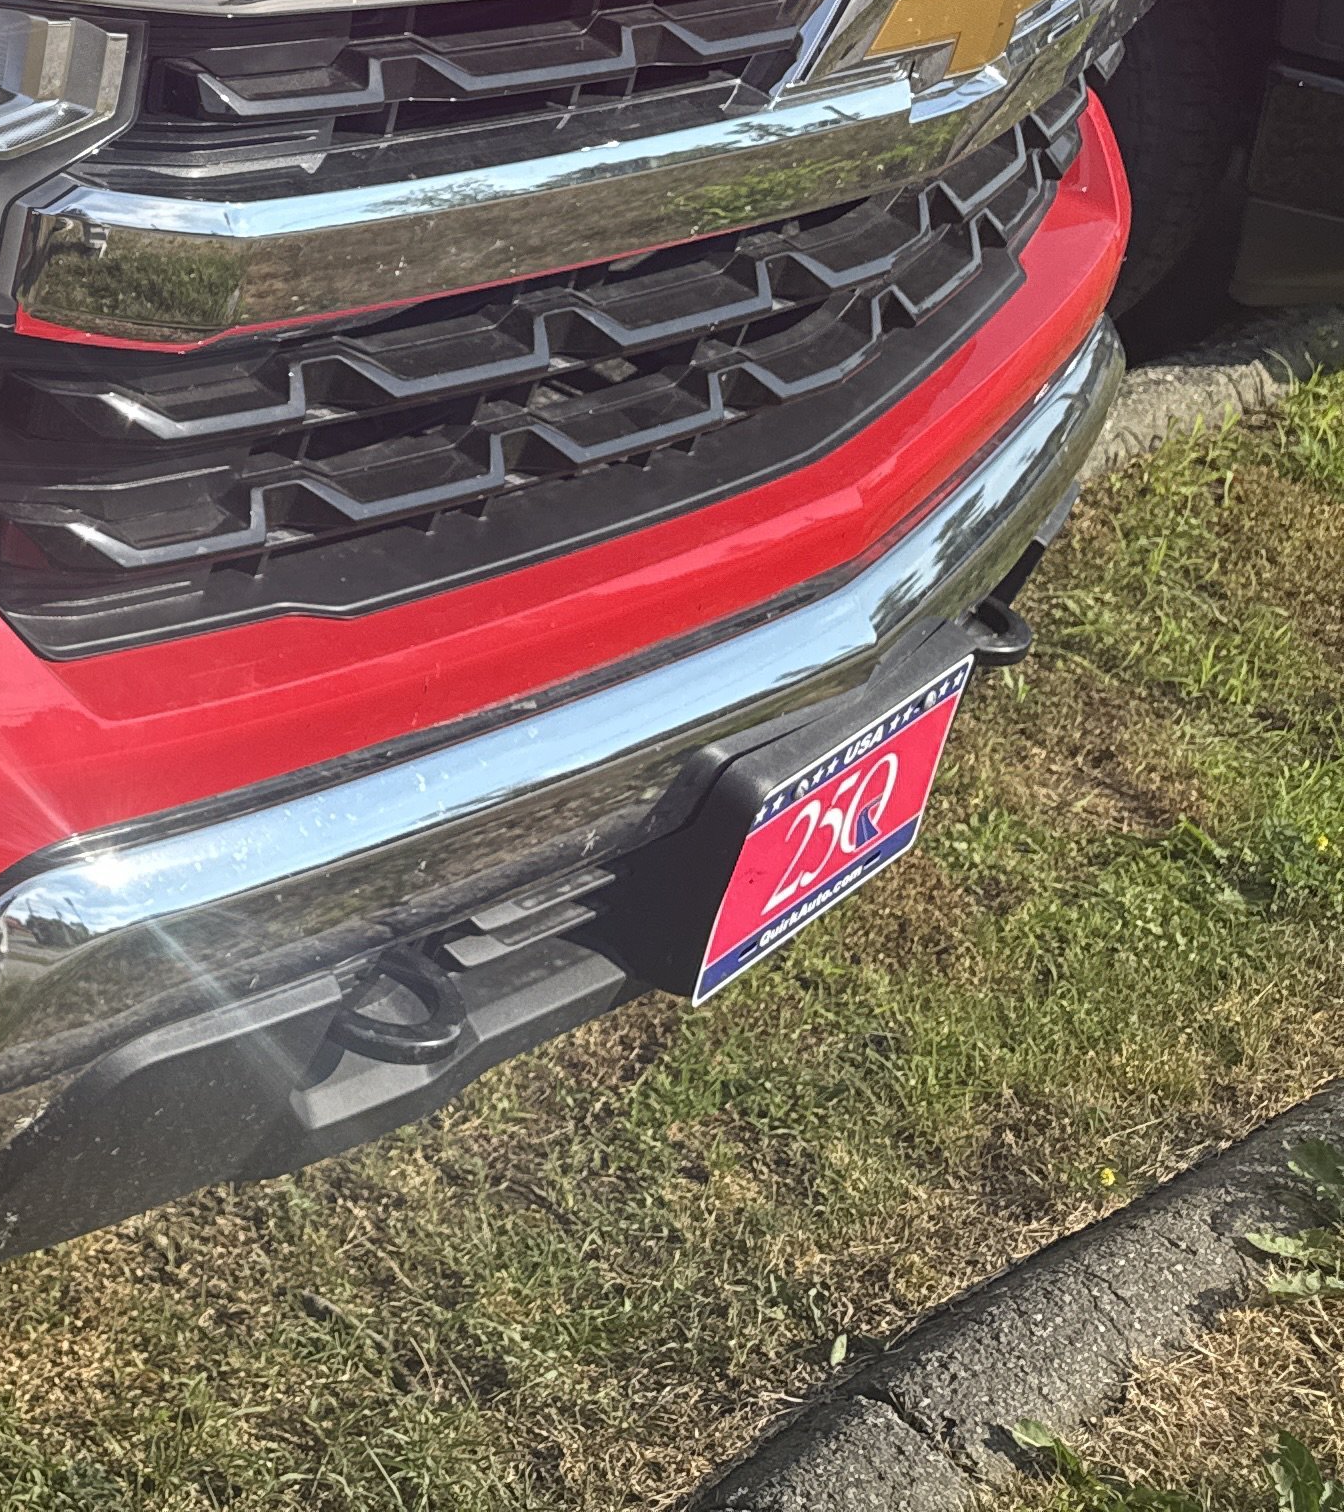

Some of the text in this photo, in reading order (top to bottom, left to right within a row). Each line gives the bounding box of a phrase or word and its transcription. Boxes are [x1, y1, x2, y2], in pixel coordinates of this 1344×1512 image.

[843, 725, 884, 765] USA
[760, 752, 899, 916] 250
[759, 865, 864, 948] QuirkAuto.com
